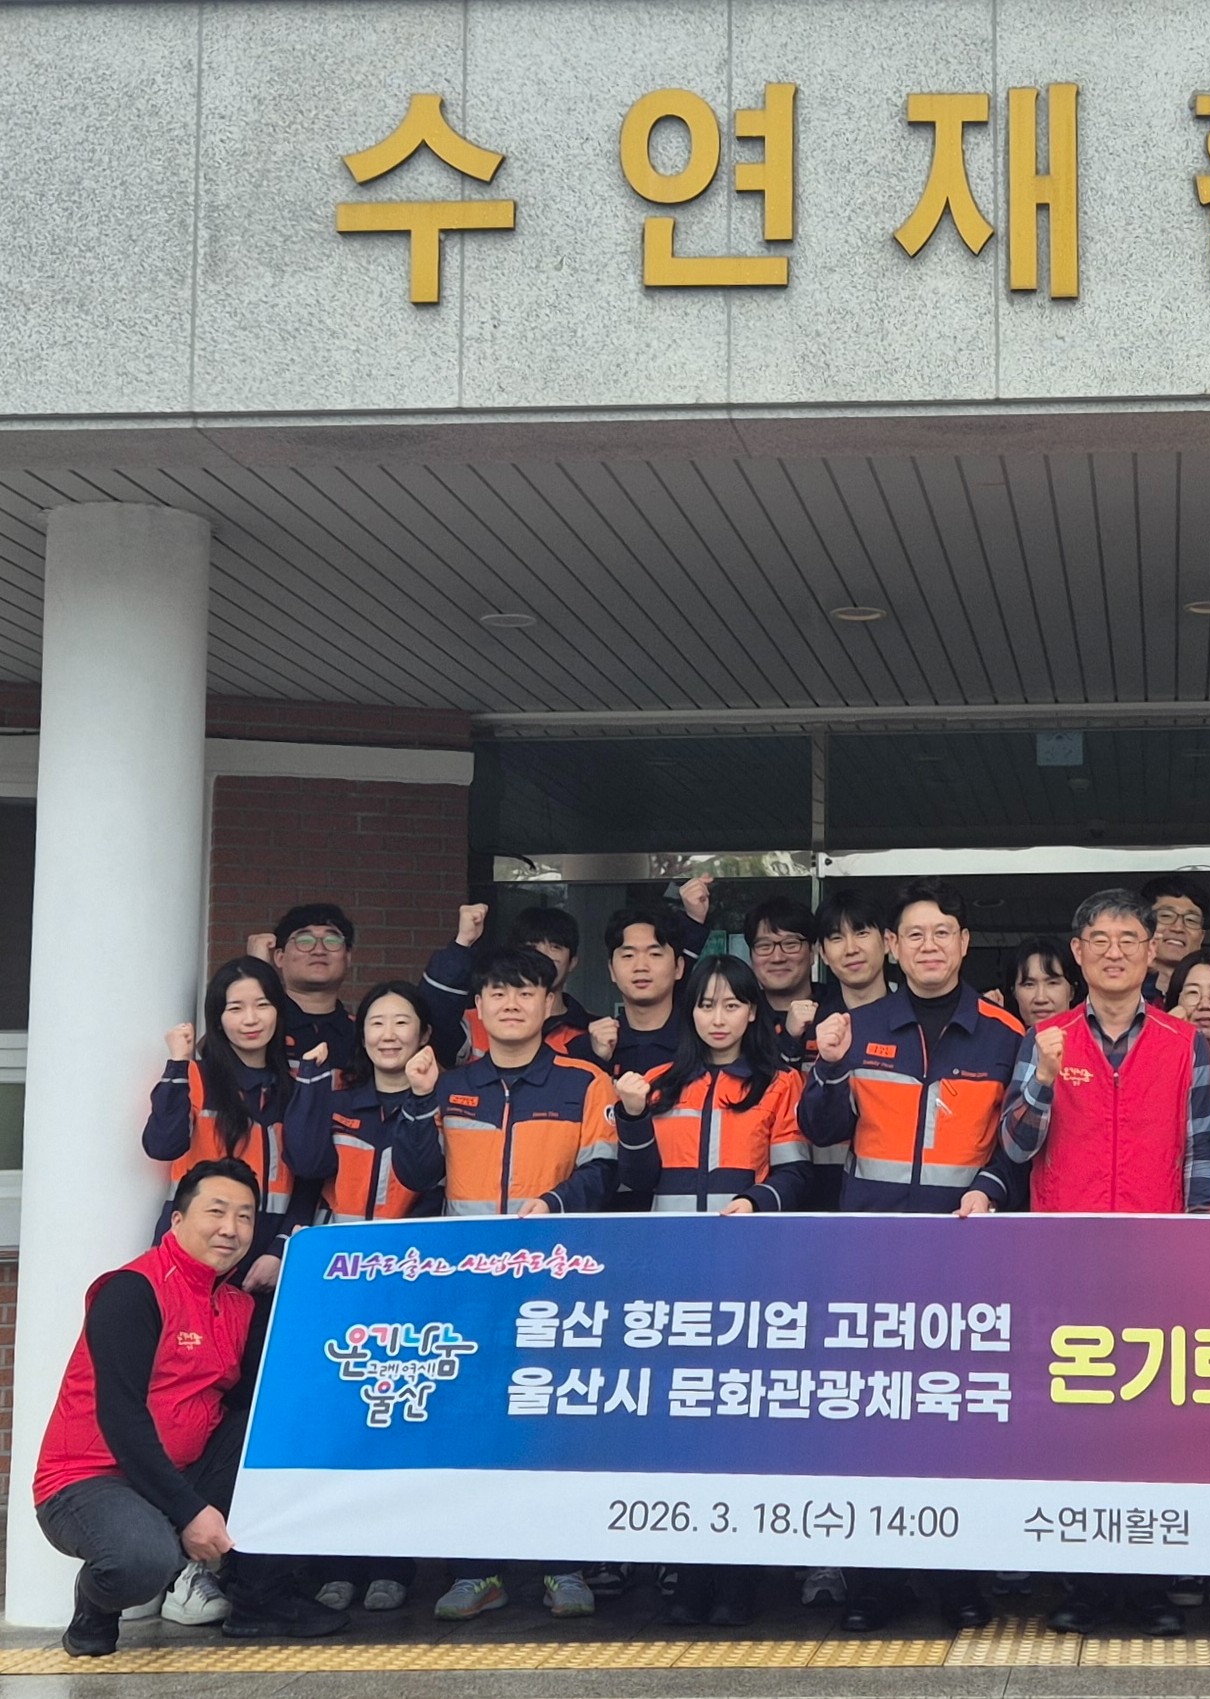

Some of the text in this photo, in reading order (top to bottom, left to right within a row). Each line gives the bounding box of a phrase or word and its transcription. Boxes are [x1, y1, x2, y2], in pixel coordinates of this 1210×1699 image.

[515, 1300, 1012, 1352] 울산 향토기업 고려아연
[327, 1326, 476, 1378] 온기나눔
[363, 1381, 433, 1424] 울산
[507, 1367, 1013, 1423] 울산시 문화관광체육국
[607, 1500, 699, 1534] 2026.
[710, 1502, 738, 1535] 3.
[869, 1505, 960, 1539] 14:00
[1023, 1507, 1190, 1546] 수연재활원
